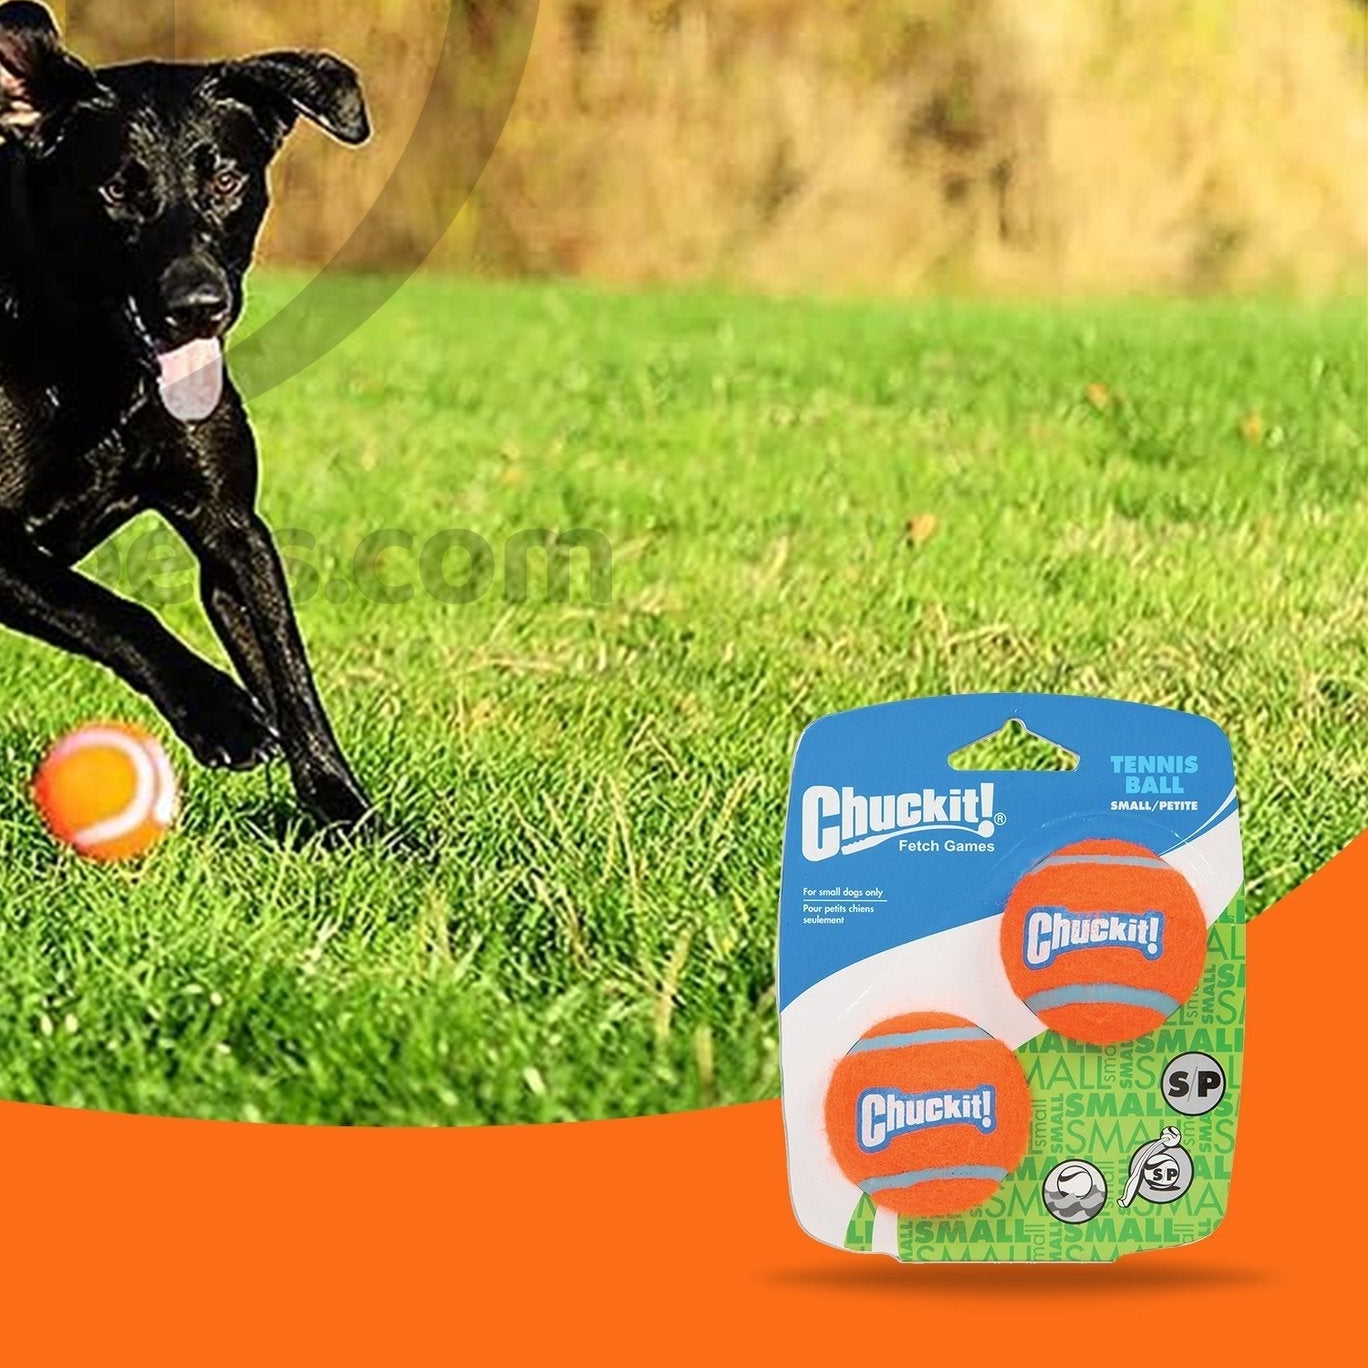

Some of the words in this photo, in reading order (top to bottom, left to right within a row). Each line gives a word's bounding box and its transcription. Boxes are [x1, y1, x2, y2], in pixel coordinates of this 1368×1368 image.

[1110, 755, 1199, 773] TENNIS
[1125, 776, 1185, 794] BALL
[1110, 800, 1198, 812] SMALL/PETITE
[898, 839, 939, 852] Fetch
[944, 839, 995, 852] Games
[803, 887, 816, 896] For
[819, 887, 841, 896] small
[843, 887, 863, 899] dogs
[865, 887, 884, 899] only
[803, 904, 822, 913] Pour
[824, 904, 846, 915] petits
[848, 903, 875, 913] chiens
[803, 915, 845, 924] seulement
[1027, 911, 1160, 965] Chuckit!
[861, 1090, 992, 1148] Chuckit!
[914, 1219, 1031, 1244] SMALL
